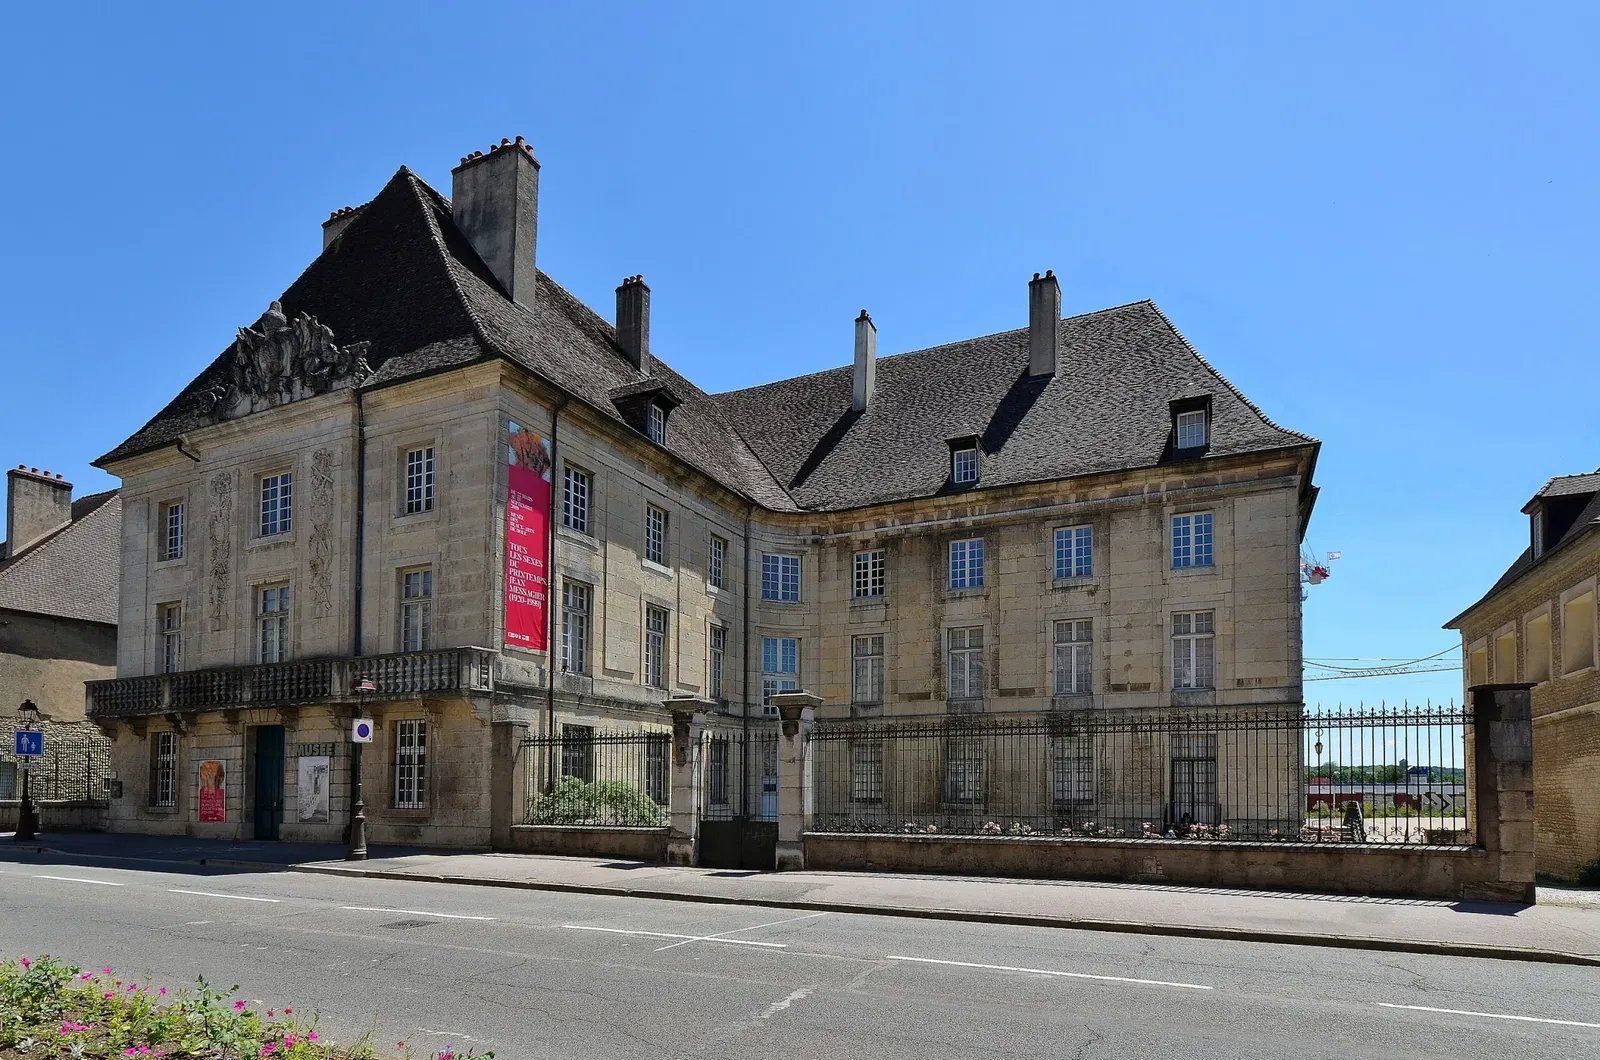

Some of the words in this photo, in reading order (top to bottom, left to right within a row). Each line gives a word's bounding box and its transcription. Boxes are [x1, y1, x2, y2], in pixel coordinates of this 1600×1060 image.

[510, 542, 528, 554] TOUS
[510, 551, 522, 561] LES
[522, 555, 543, 568] SEXES
[510, 559, 519, 568] DU
[510, 576, 526, 587] JEAN
[509, 585, 545, 601] MESSAGIER
